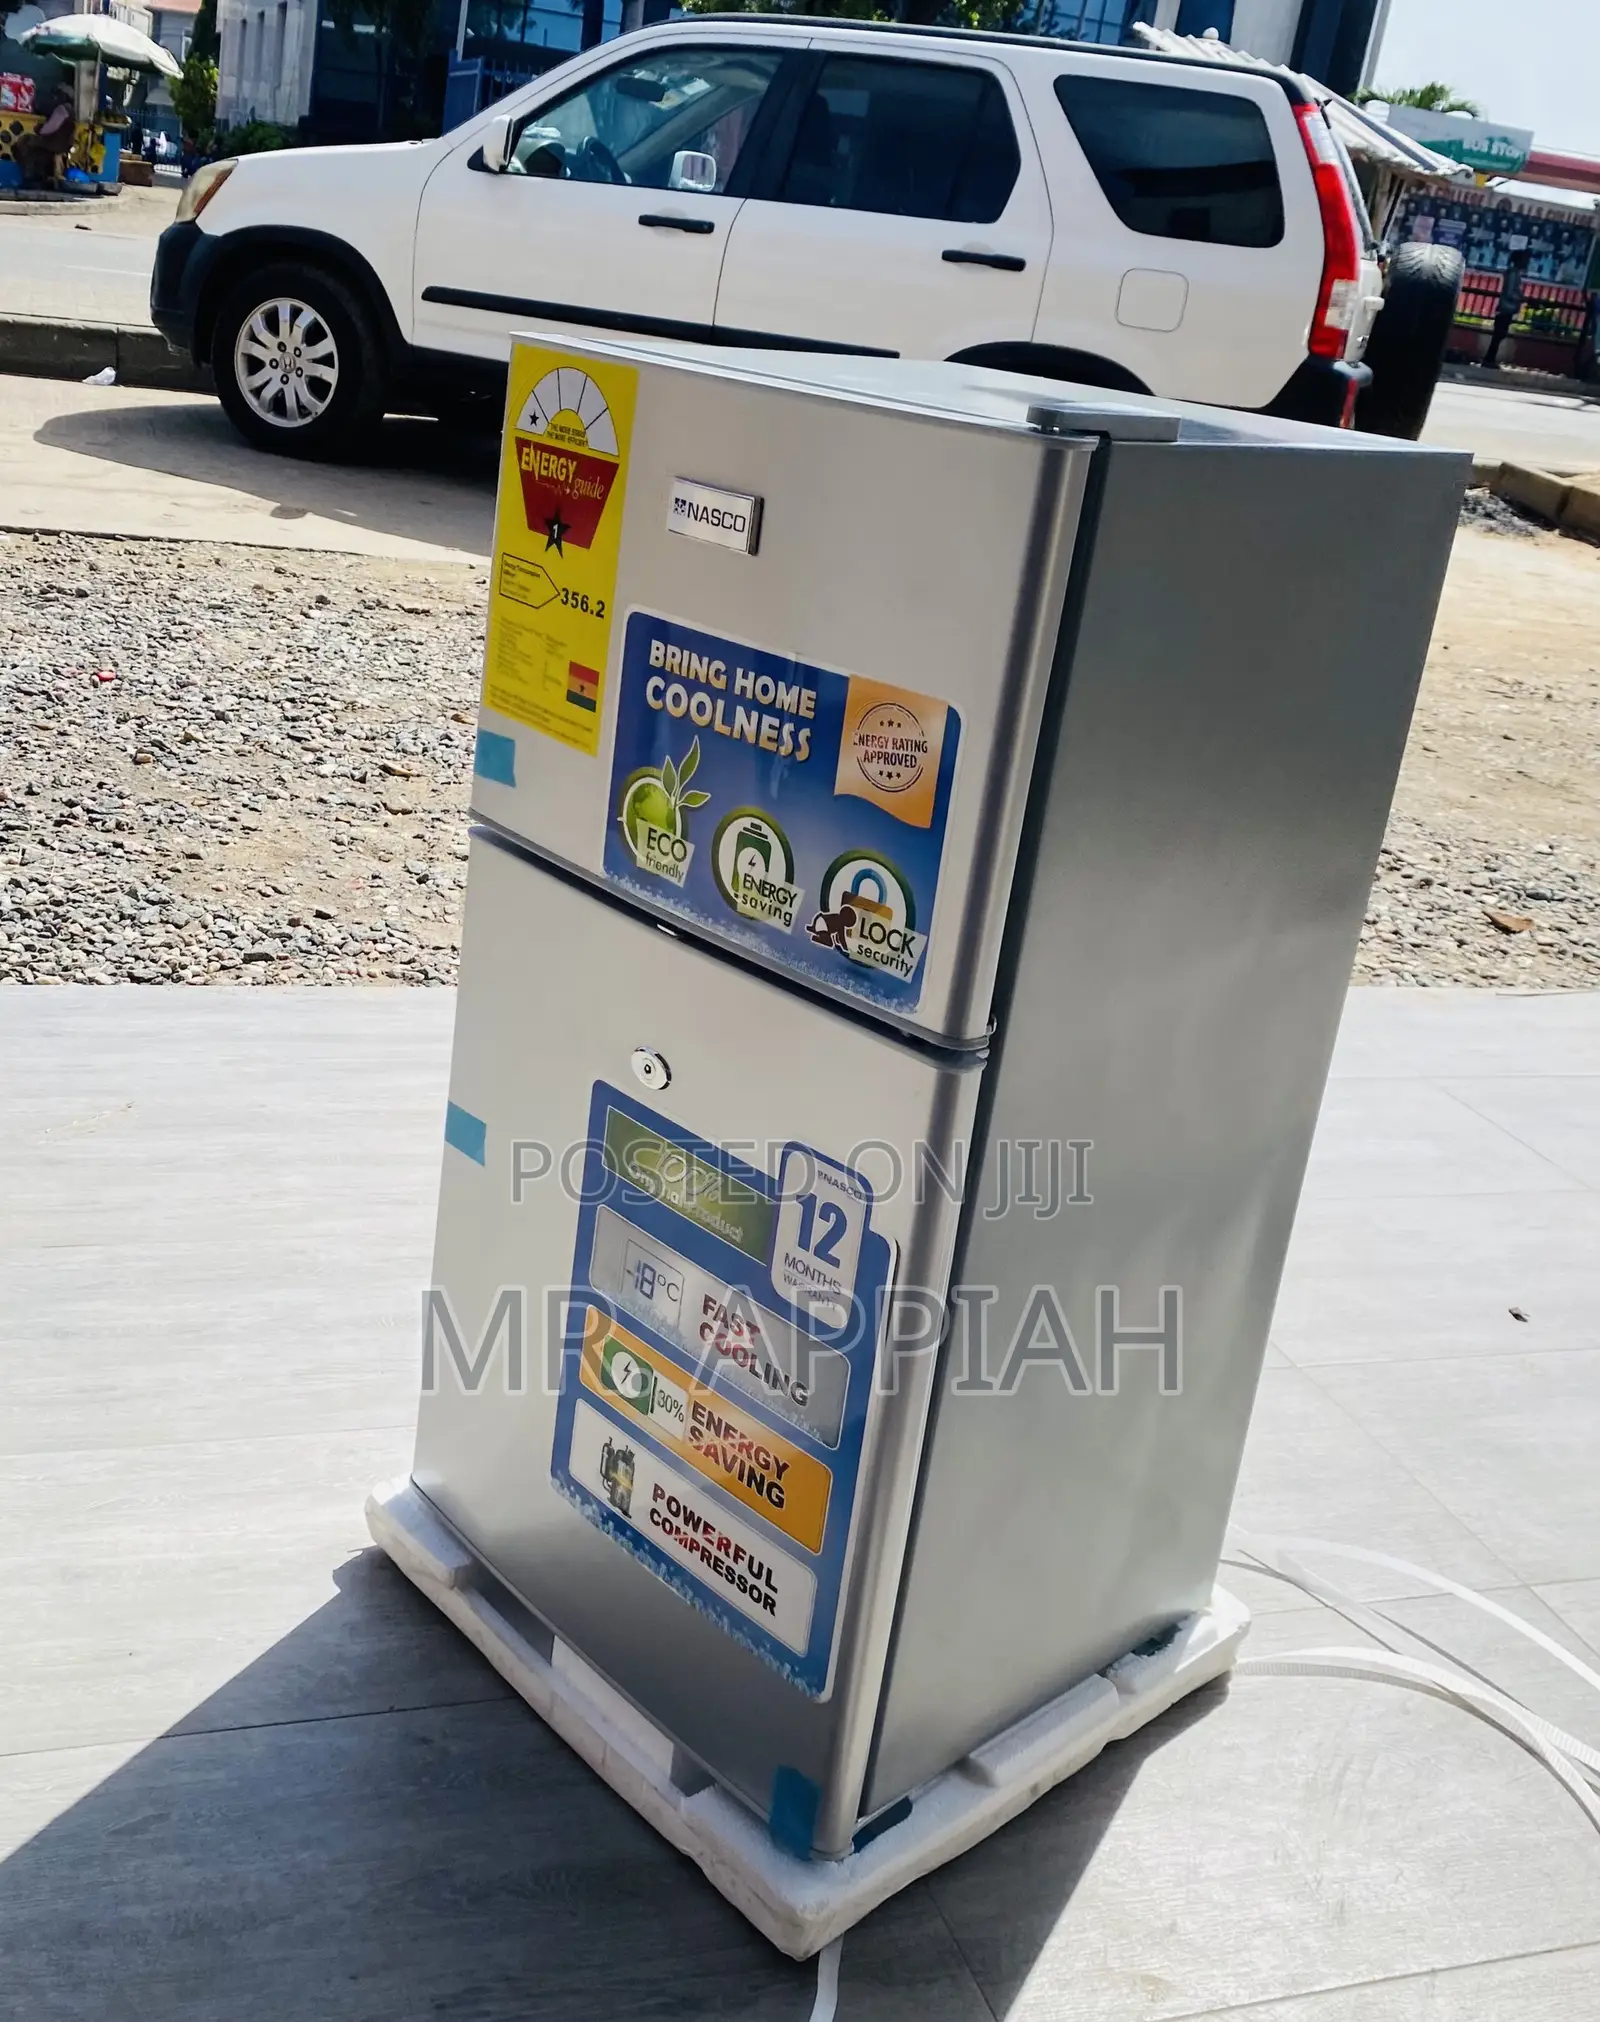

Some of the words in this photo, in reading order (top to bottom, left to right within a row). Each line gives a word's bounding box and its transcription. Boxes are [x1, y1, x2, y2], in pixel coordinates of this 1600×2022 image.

[521, 441, 577, 483] ENERGY
[571, 475, 604, 500] guide
[553, 523, 559, 539] 1
[687, 502, 746, 533] NASCO
[560, 587, 606, 619] 356.2
[649, 639, 728, 690] BRING
[734, 666, 818, 720] HOME
[645, 675, 812, 763] COOLNESS
[863, 749, 918, 768] APPROVED
[891, 736, 928, 754] RATING
[646, 827, 688, 862] ECO
[644, 850, 685, 884] friendly
[742, 872, 799, 909] ENERGY
[741, 893, 794, 928] saving
[859, 915, 916, 960] LOCK
[857, 942, 914, 978] security
[823, 1173, 863, 1200] NASCO
[795, 1192, 848, 1269] 12
[784, 1252, 842, 1295] MONTHS
[702, 1293, 761, 1346] FAST
[699, 1321, 809, 1407] COOLING
[656, 1389, 685, 1422] 30%
[691, 1401, 791, 1481] ENERGY
[689, 1424, 786, 1510] SAVING
[652, 1482, 779, 1594] POWERFUL
[649, 1506, 777, 1617] COMPRESSOR
